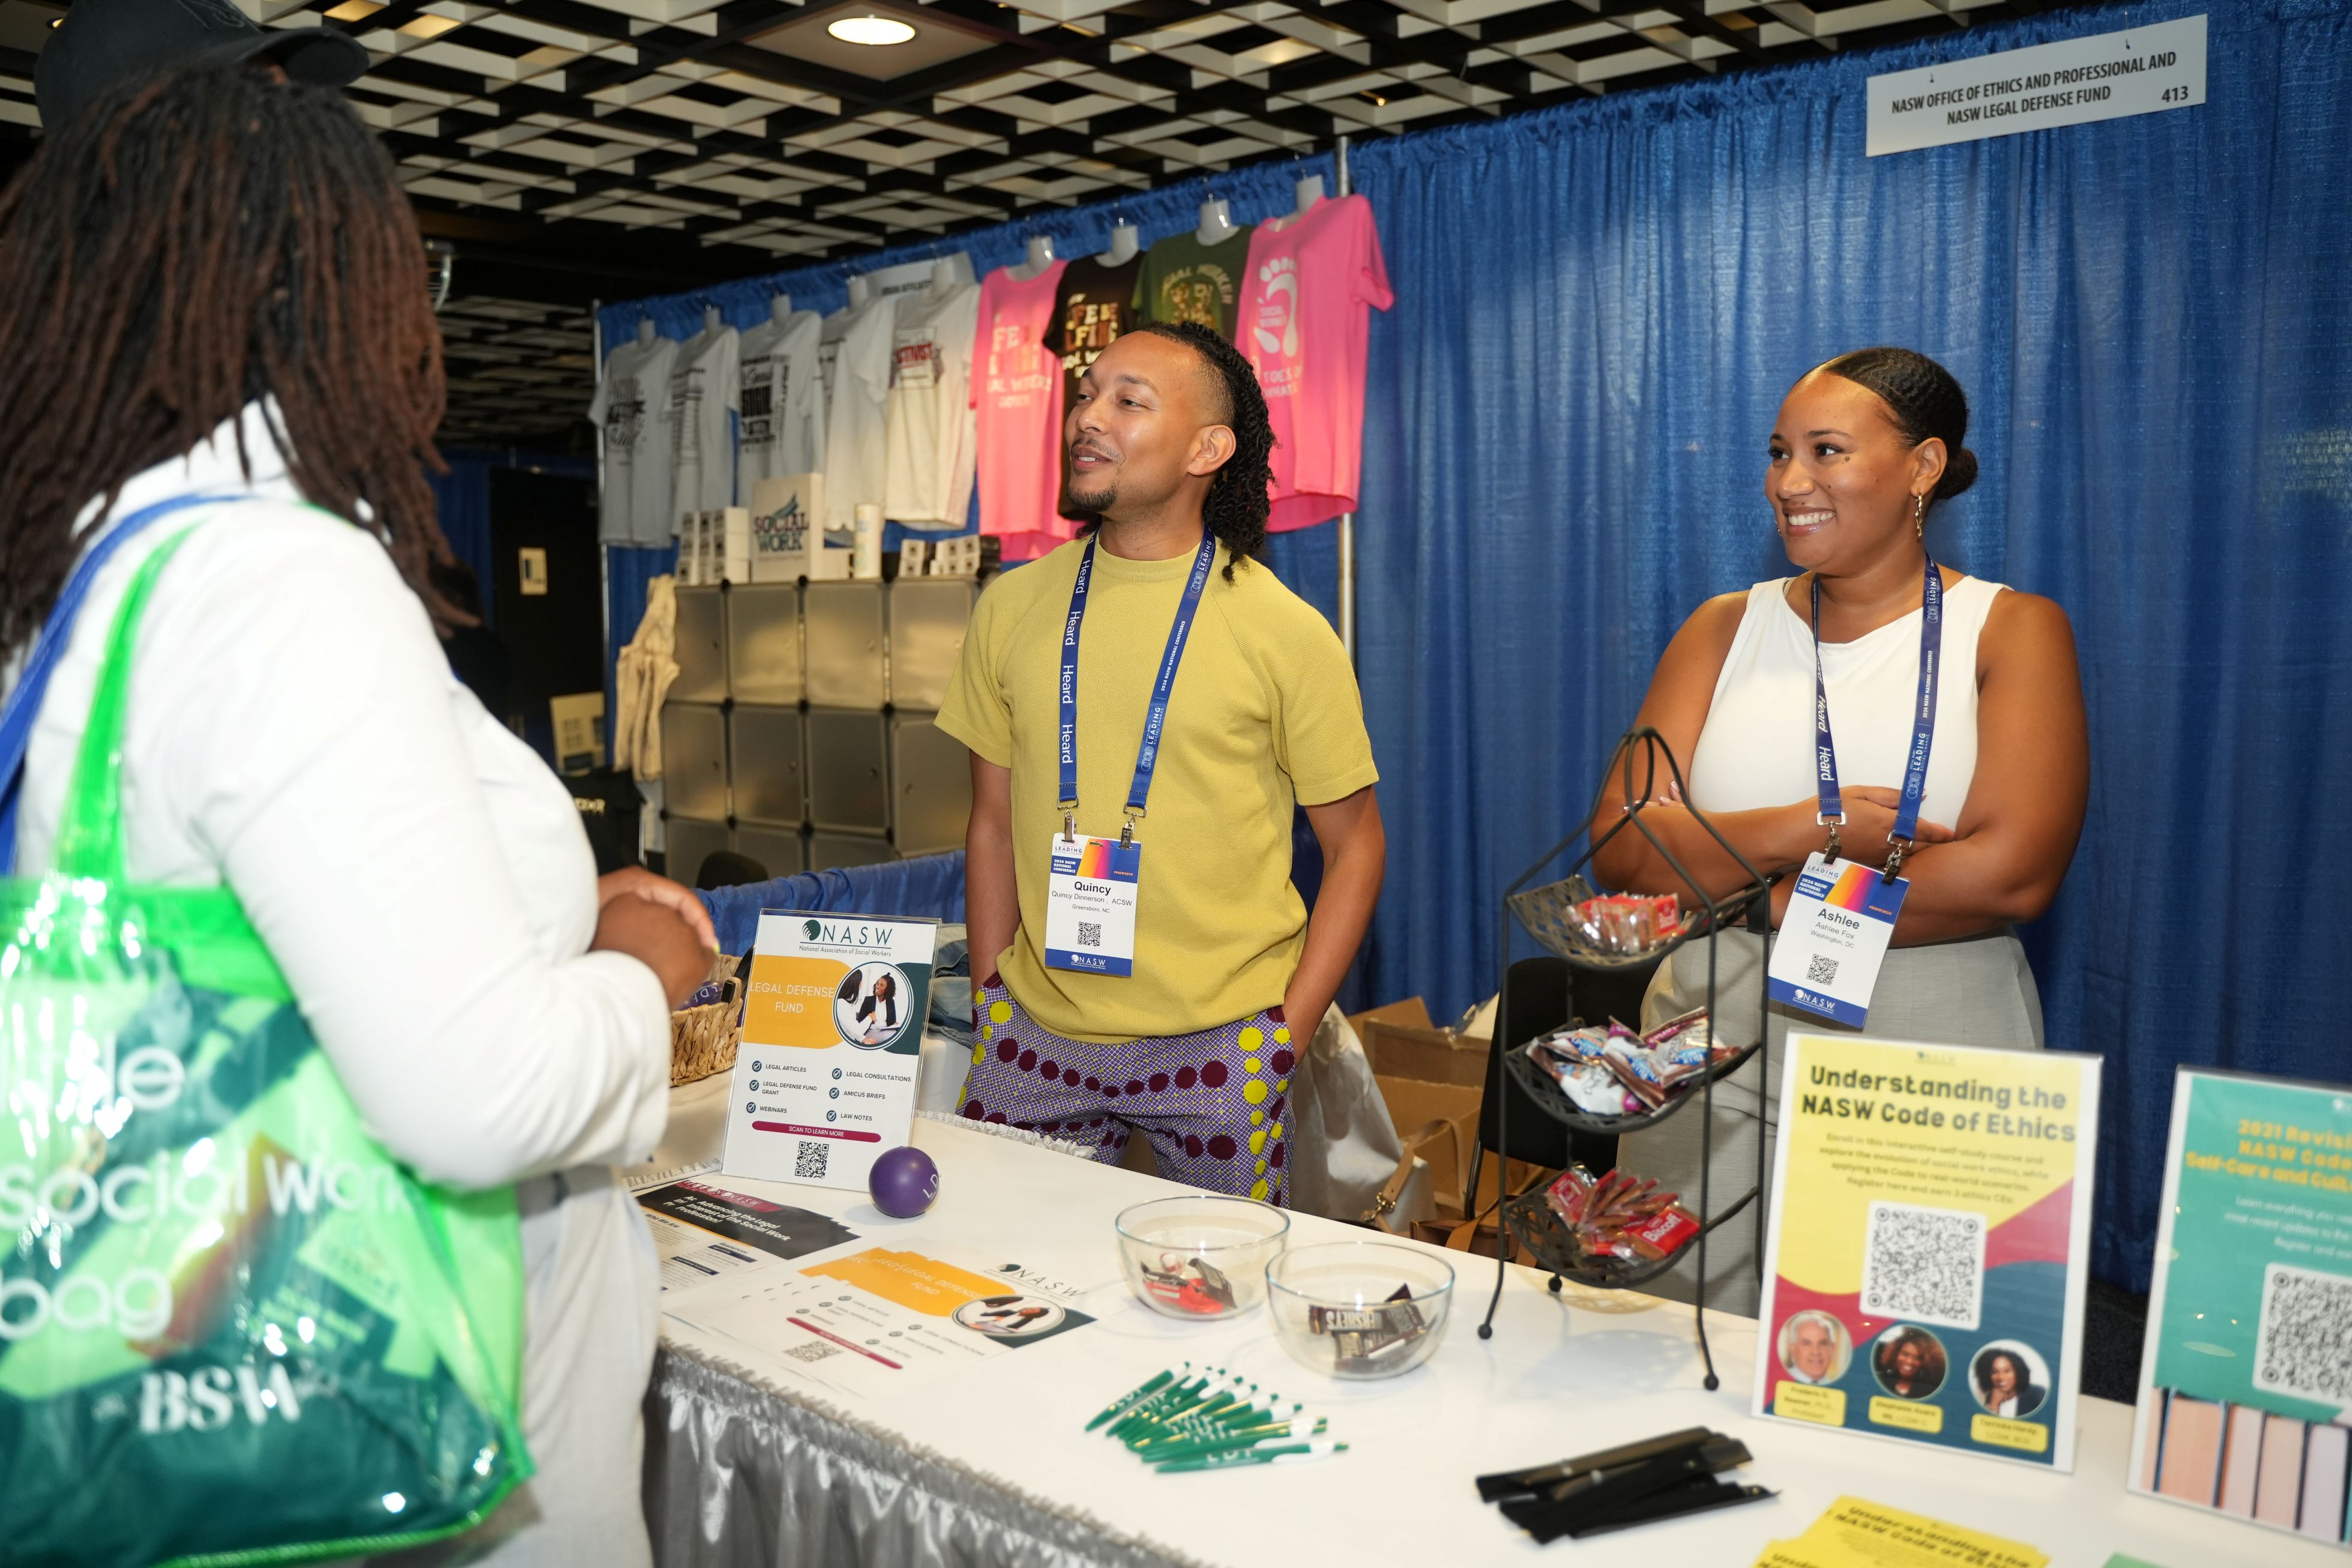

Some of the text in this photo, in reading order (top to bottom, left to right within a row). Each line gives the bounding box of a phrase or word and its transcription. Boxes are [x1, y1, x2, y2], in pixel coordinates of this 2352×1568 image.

[1892, 52, 2177, 113] NASW OFFICE OF ETHICS AND PROFESSIONAL AND
[2162, 86, 2188, 103] 413
[1947, 86, 2111, 125] NASW LEGAL DEFENSE FUND
[753, 512, 809, 534] SOCIAL
[758, 532, 802, 551] WORK
[1199, 540, 1211, 571] LEADING
[1075, 559, 1091, 594] Heard
[1065, 611, 1081, 646] Heard
[1169, 646, 1178, 666] NATIONAL
[1175, 621, 1186, 645] CONFERENCE
[1062, 665, 1074, 704] Heard
[1148, 707, 1161, 744] LEADING
[1818, 695, 1828, 733] Heard
[1062, 724, 1073, 764] Heard
[1913, 733, 1926, 771] LEADING
[1818, 746, 1835, 781] Heard
[1808, 865, 1839, 878] LEADING
[1051, 891, 1072, 899] Quincy
[1074, 894, 1105, 903] Dinnerson
[1075, 881, 1111, 896] Quincy
[1798, 887, 1824, 898] CONFERENCE
[1800, 882, 1821, 892] NATIONAL
[1072, 904, 1101, 912] Greensboro,
[1817, 908, 1860, 929] Ashlee
[822, 924, 893, 945] NASW
[1811, 930, 1843, 945] Washington,
[1815, 921, 1854, 939] Ashlee Fox
[1079, 956, 1106, 966] NASW
[750, 982, 835, 998] LEGAL DEFENSE
[1803, 992, 1835, 1009] NASW
[776, 1002, 803, 1013] FUND
[864, 1073, 911, 1082] CONSULTATIONS
[1811, 1064, 2066, 1111] Understanding the
[1802, 1094, 2076, 1142] NASW Code of Ethics
[2239, 1118, 2282, 1139] 2021
[1827, 1132, 1853, 1143] Enroll
[1866, 1138, 1883, 1146] this
[1886, 1140, 1937, 1153] interactive
[1939, 1146, 1987, 1159] self-study
[1989, 1152, 2022, 1162] course
[2025, 1156, 2043, 1165] and
[2239, 1139, 2352, 1171] NASW Code
[1819, 1147, 1853, 1157] explore
[1856, 1150, 1871, 1159] the
[1873, 1153, 1917, 1164] evolution
[1932, 1160, 1959, 1169] social
[1962, 1163, 1984, 1172] work
[2022, 1171, 2049, 1180] while
[1832, 1162, 1871, 1174] applying
[1873, 1166, 1888, 1175] the
[1891, 1168, 1915, 1178] Code
[1929, 1173, 1979, 1186] real-world
[2186, 1151, 2309, 1186] Self-Care and
[0, 1144, 248, 1229] social
[1847, 1177, 1884, 1188] Register
[1886, 1181, 1907, 1191] here
[1910, 1185, 1928, 1193] and
[1930, 1187, 1951, 1196] earn
[1962, 1191, 1991, 1201] ethics
[729, 1193, 762, 1205] NASW
[675, 1206, 723, 1223] Profession!
[686, 1203, 720, 1216] Interest
[728, 1216, 743, 1224] the
[741, 1220, 768, 1234] Social
[766, 1229, 792, 1241] Work
[697, 1200, 741, 1217] Advancing
[754, 1219, 781, 1229] Legal
[1641, 1213, 1682, 1243] Biscoff
[719, 1242, 749, 1255] Resources
[902, 1267, 935, 1283] LEGAL
[936, 1279, 984, 1300] DEFENSE
[909, 1281, 941, 1295] FUND
[1018, 1269, 1086, 1297] NASW
[139, 1363, 301, 1435] BSW
[1834, 1513, 1889, 1534] NASW
